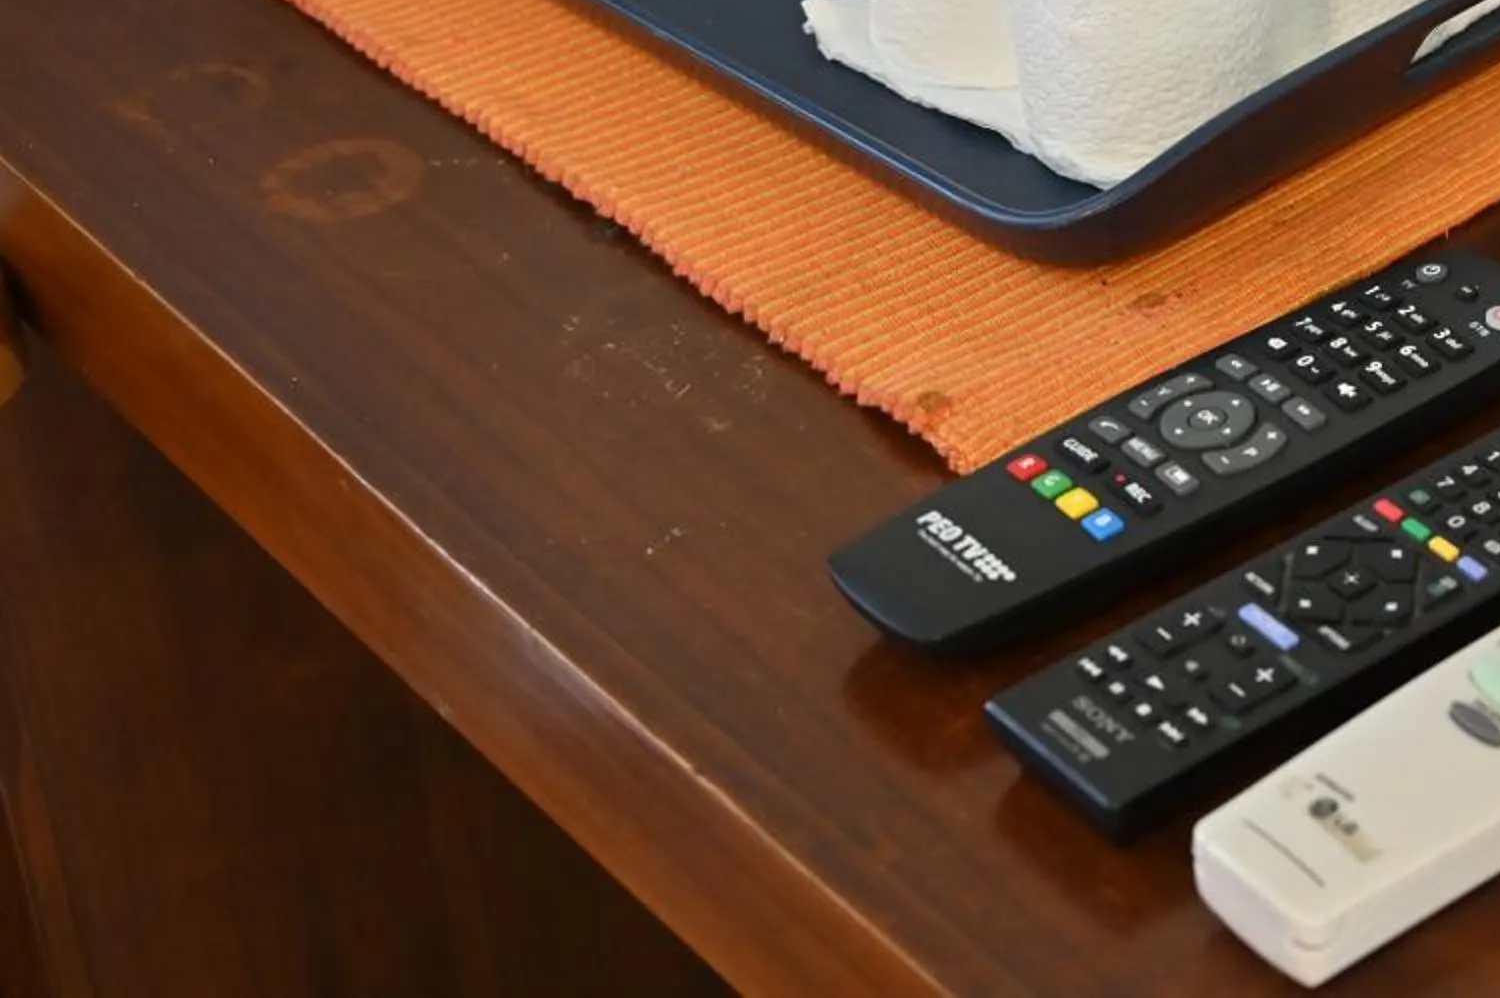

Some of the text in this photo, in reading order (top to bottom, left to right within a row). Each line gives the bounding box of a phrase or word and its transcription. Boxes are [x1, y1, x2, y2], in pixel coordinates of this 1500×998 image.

[1364, 285, 1380, 296] 1
[1331, 301, 1348, 313] 4
[1398, 304, 1417, 316] 2
[1294, 316, 1313, 327] 7
[1364, 320, 1384, 332] 5
[1433, 327, 1452, 340] 3
[1329, 336, 1349, 349] 8
[1400, 344, 1418, 357] 6
[1296, 355, 1315, 367] 0
[1364, 360, 1383, 373] 9
[1197, 408, 1220, 426] OK
[1063, 436, 1099, 463] GUIDE
[1461, 463, 1480, 476] 4
[1436, 475, 1456, 489] 7
[1123, 481, 1153, 504] REC
[1471, 500, 1492, 515] 8
[1447, 514, 1467, 529] 0
[916, 510, 964, 542] PEO
[952, 532, 989, 561] TV
